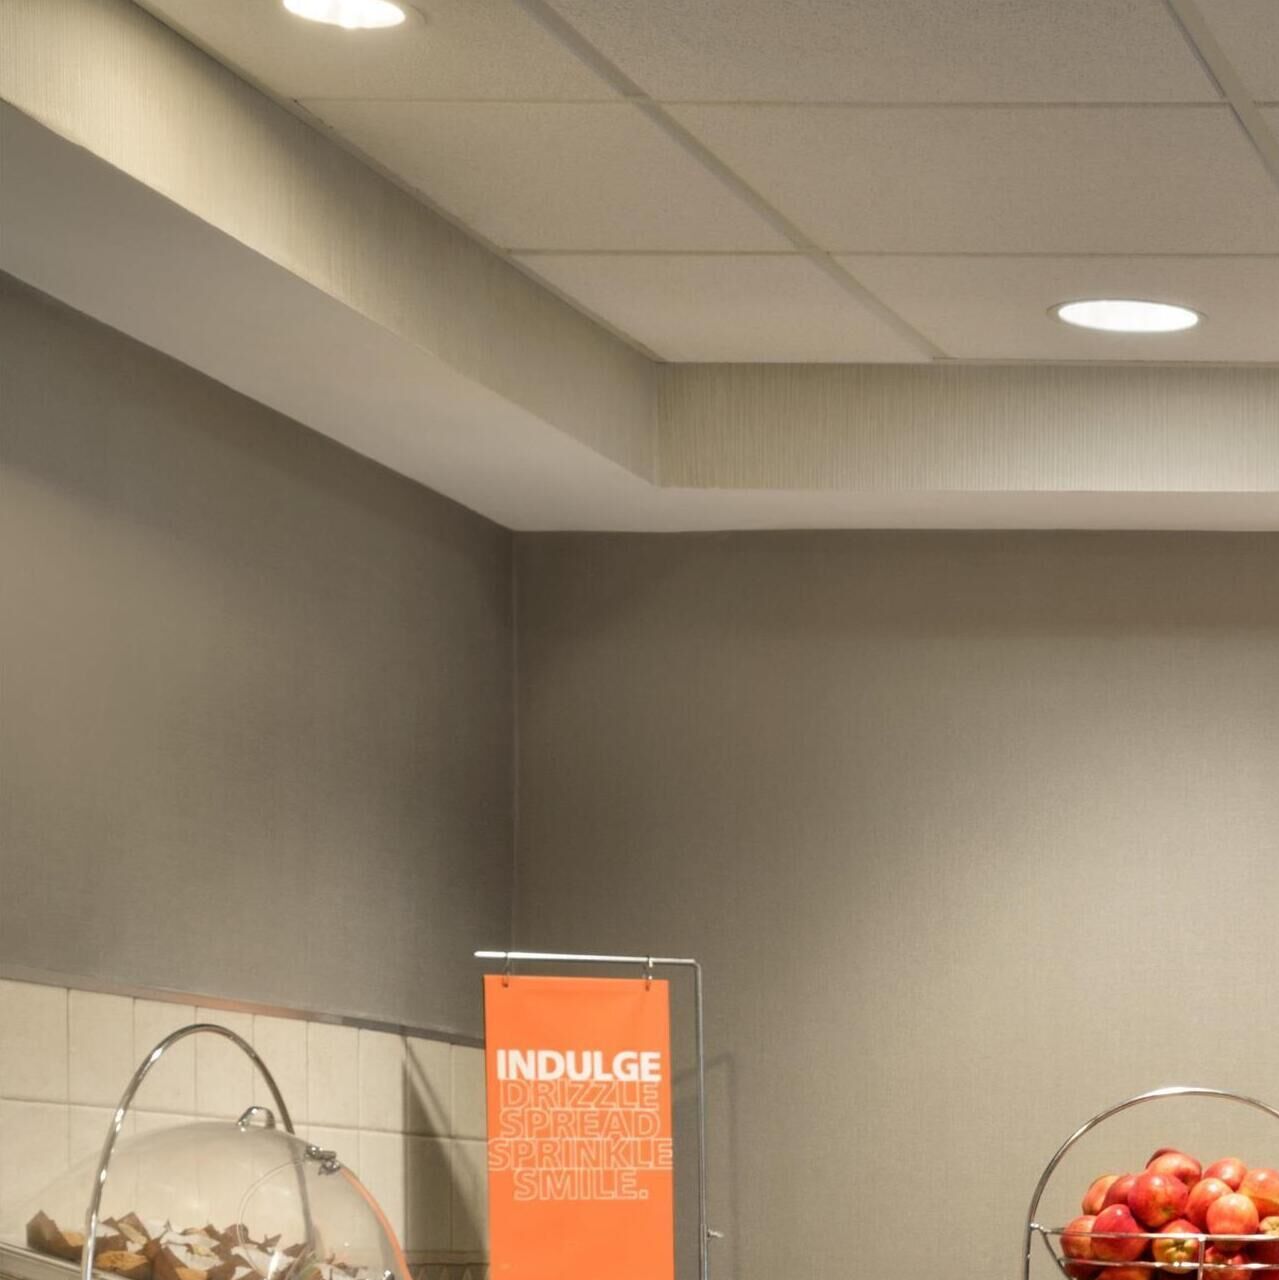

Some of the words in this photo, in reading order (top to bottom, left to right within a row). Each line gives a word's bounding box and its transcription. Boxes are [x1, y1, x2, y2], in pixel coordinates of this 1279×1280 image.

[496, 1049, 662, 1082] INDULGE
[500, 1080, 660, 1110] DRIZZLE
[500, 1108, 661, 1139] SPREAD
[488, 1137, 673, 1170] SPRINKLE
[514, 1167, 649, 1201] SMILE.
